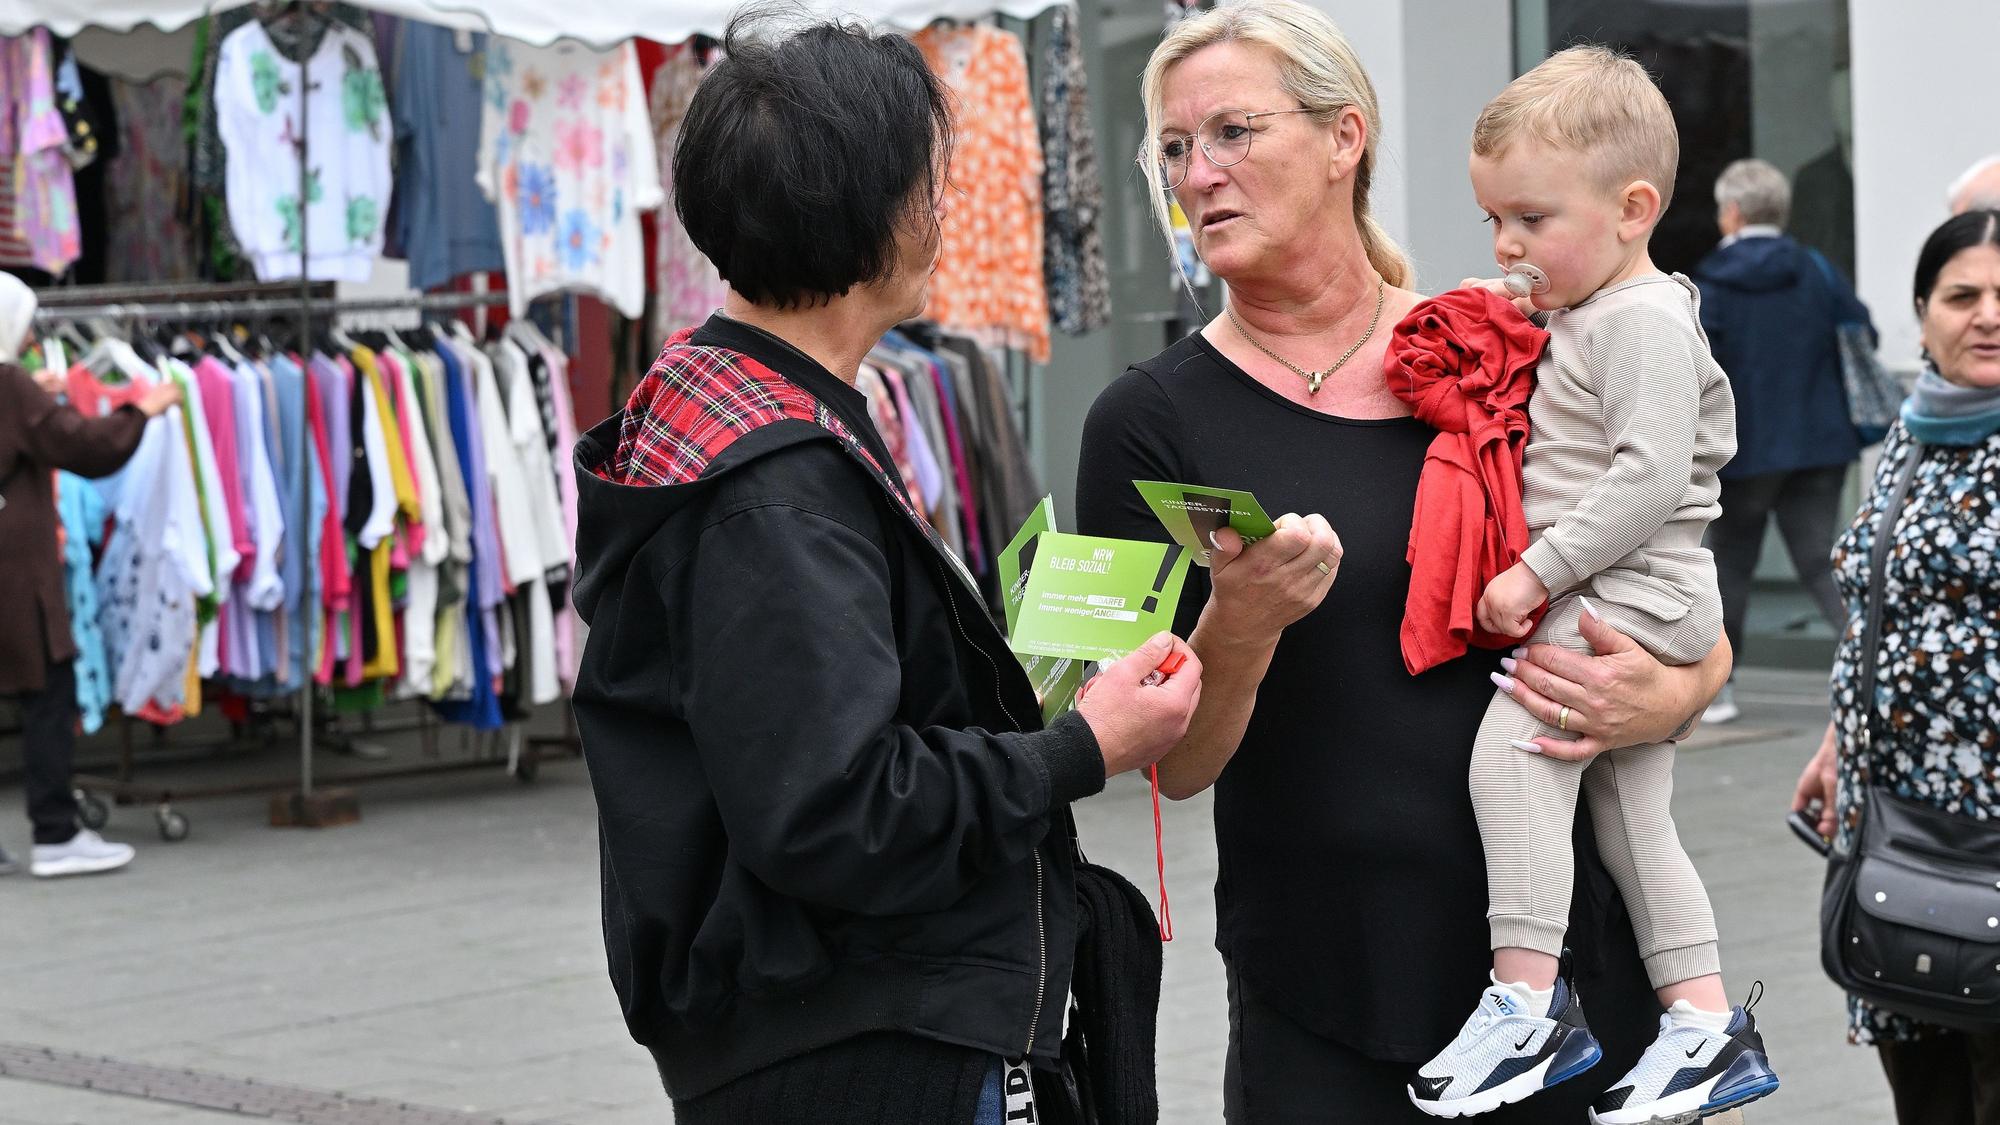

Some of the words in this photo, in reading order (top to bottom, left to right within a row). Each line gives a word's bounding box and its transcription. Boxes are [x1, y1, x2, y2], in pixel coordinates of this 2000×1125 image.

[1092, 547, 1115, 562] NRW
[1049, 556, 1076, 571] BLEIB
[1077, 559, 1111, 575] SOZIAL!
[1068, 594, 1087, 603] mehr
[1064, 605, 1093, 617] weniger
